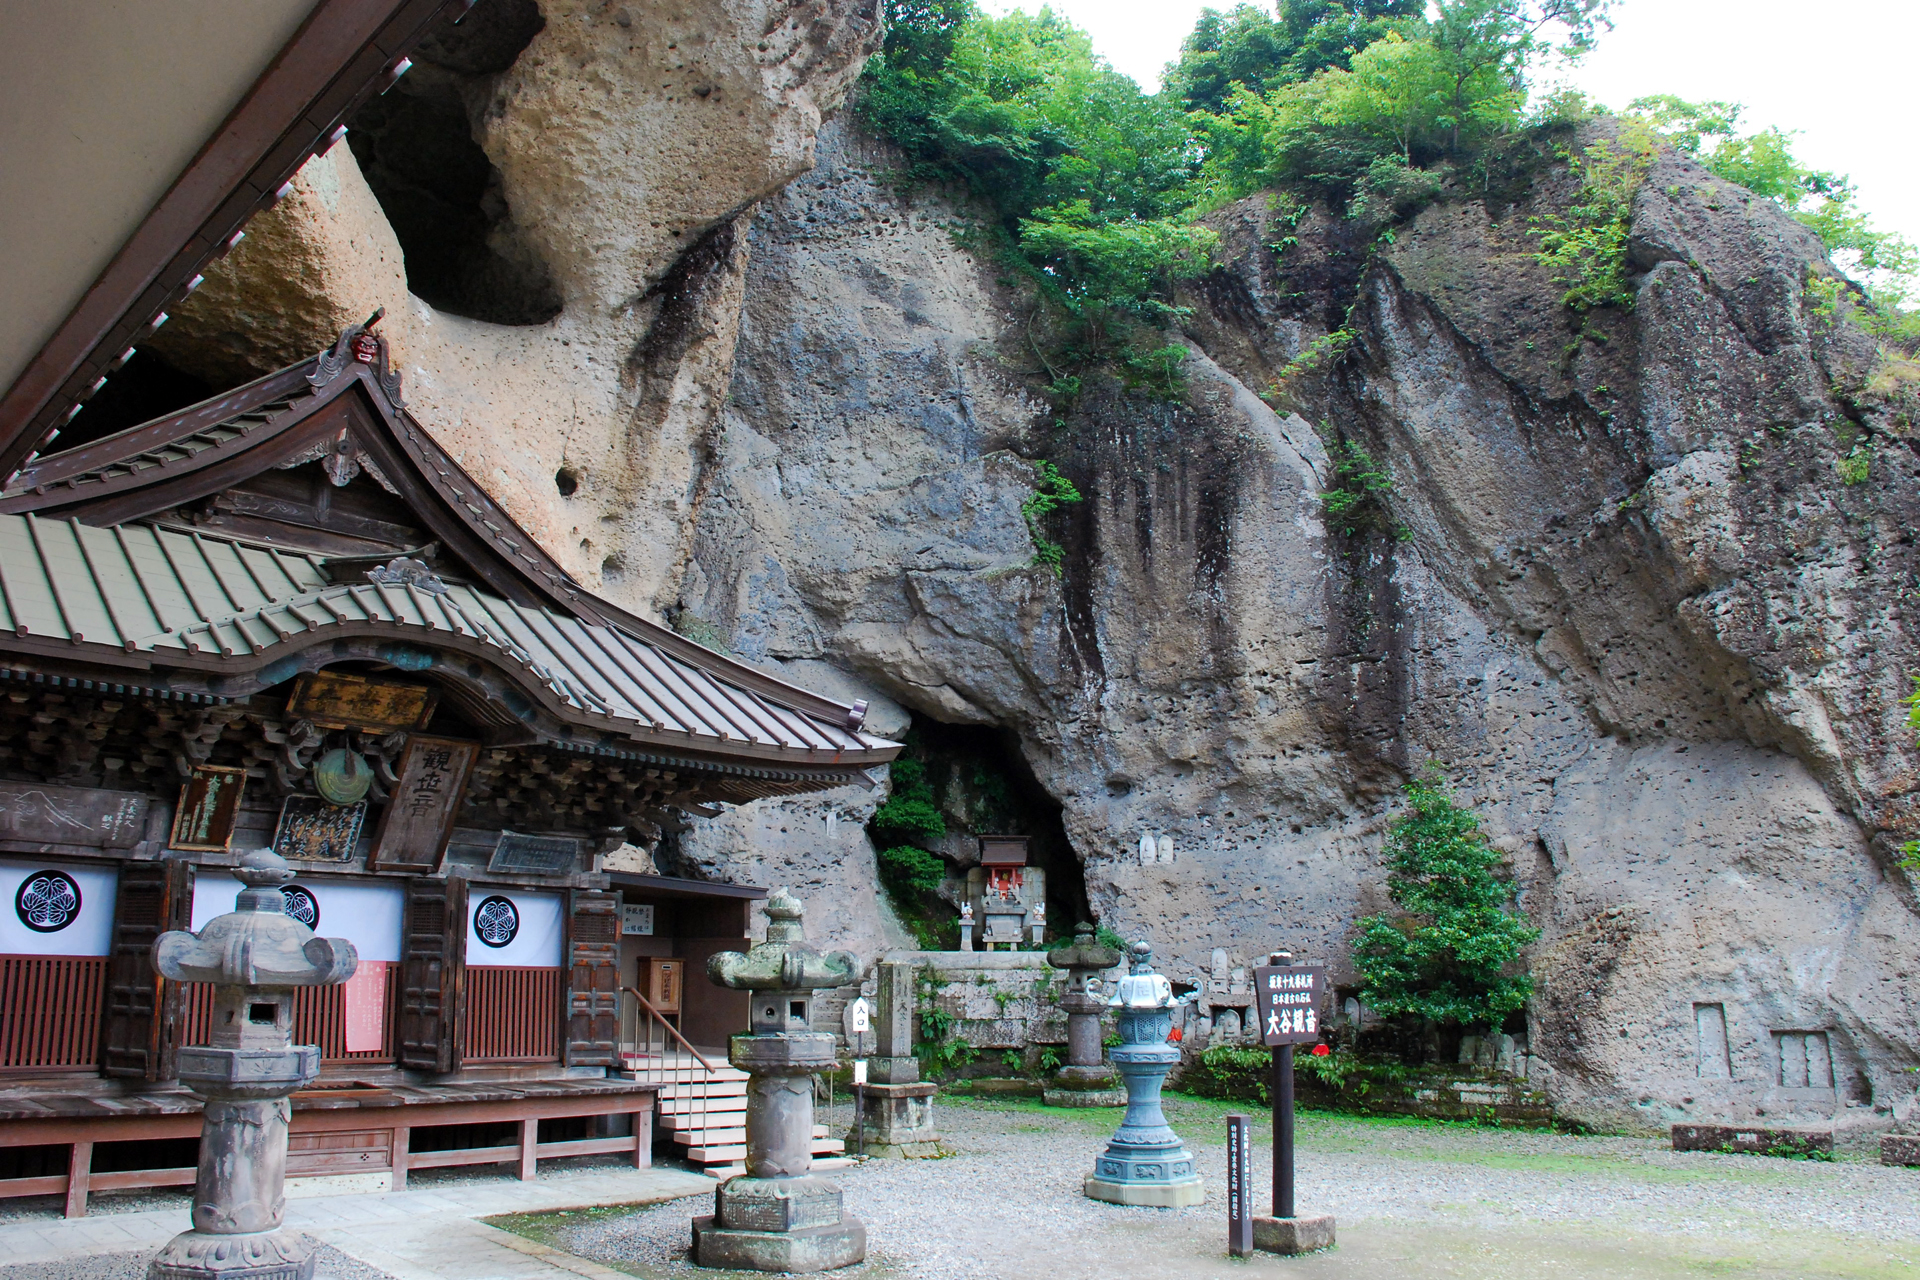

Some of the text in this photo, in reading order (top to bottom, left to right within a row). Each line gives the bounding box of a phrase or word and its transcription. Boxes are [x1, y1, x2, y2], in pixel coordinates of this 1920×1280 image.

[1272, 992, 1311, 1005] 日本最古の石仏
[857, 1006, 866, 1026] 入口
[1266, 1007, 1317, 1035] 大谷観音
